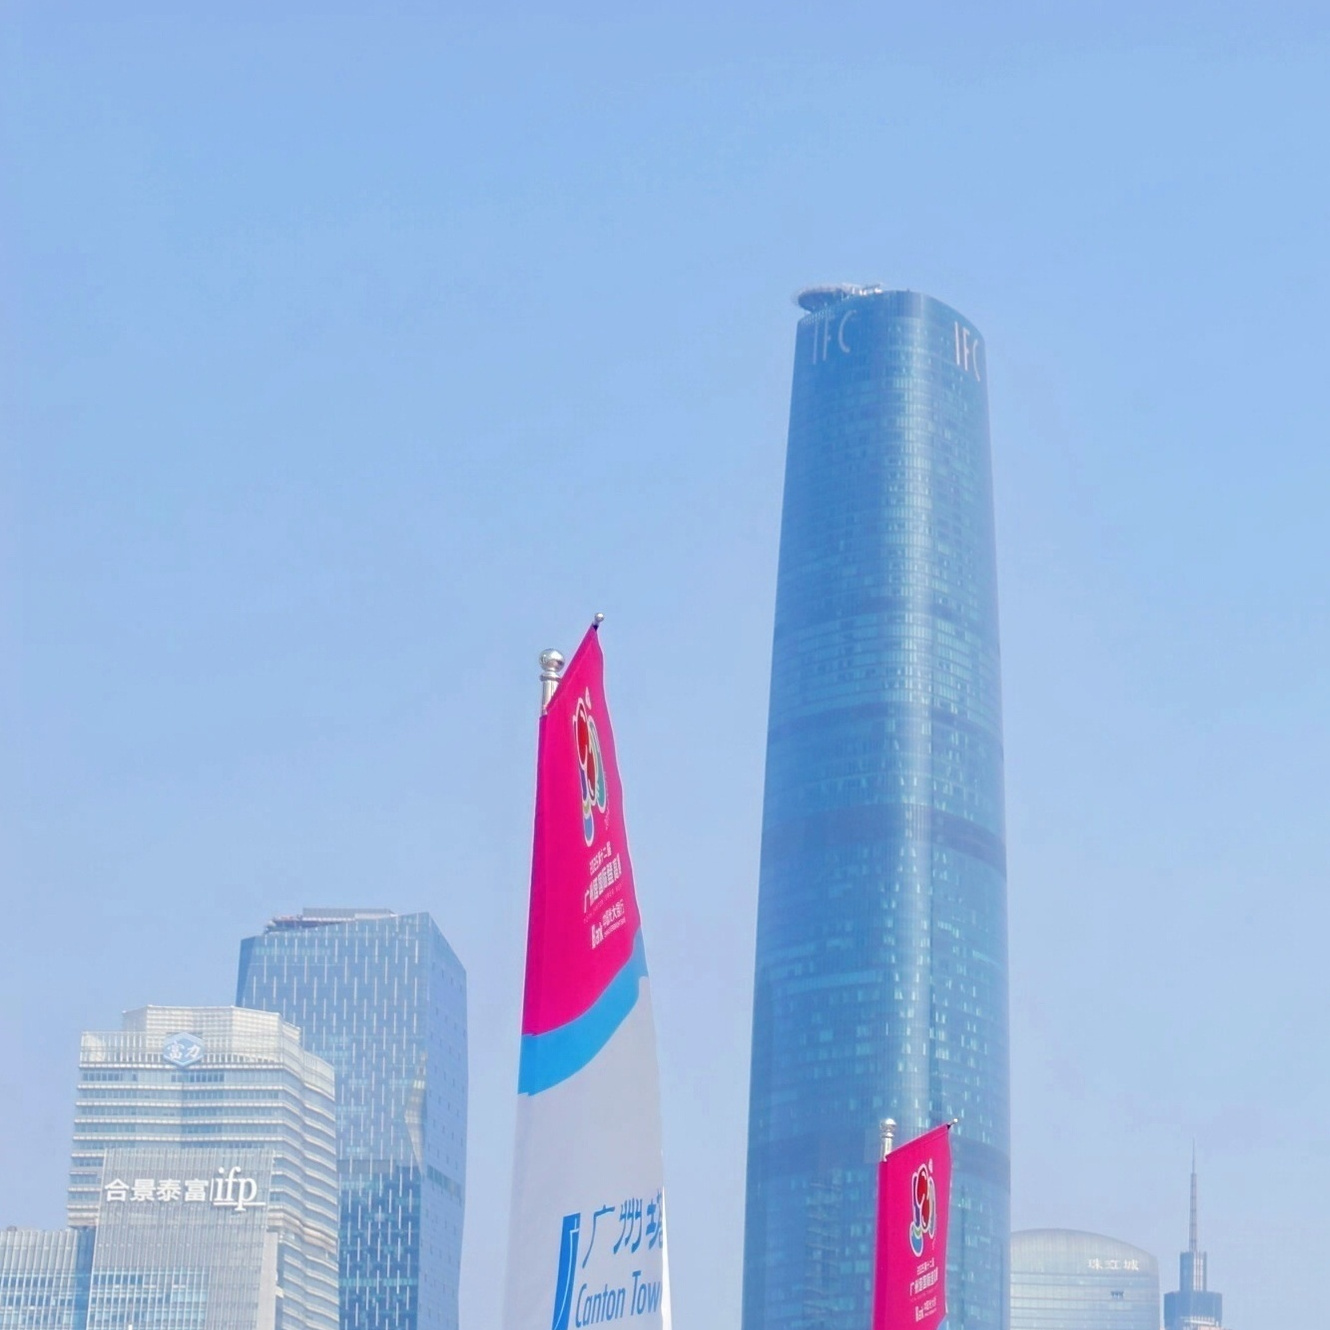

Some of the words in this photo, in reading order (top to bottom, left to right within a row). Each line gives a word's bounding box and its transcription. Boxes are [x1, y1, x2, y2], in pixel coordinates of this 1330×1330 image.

[953, 321, 981, 382] IFC
[104, 1178, 209, 1203] 合景泰富
[214, 1166, 257, 1212] ifp
[575, 1283, 626, 1328] Canton
[631, 1270, 662, 1316] Tow
